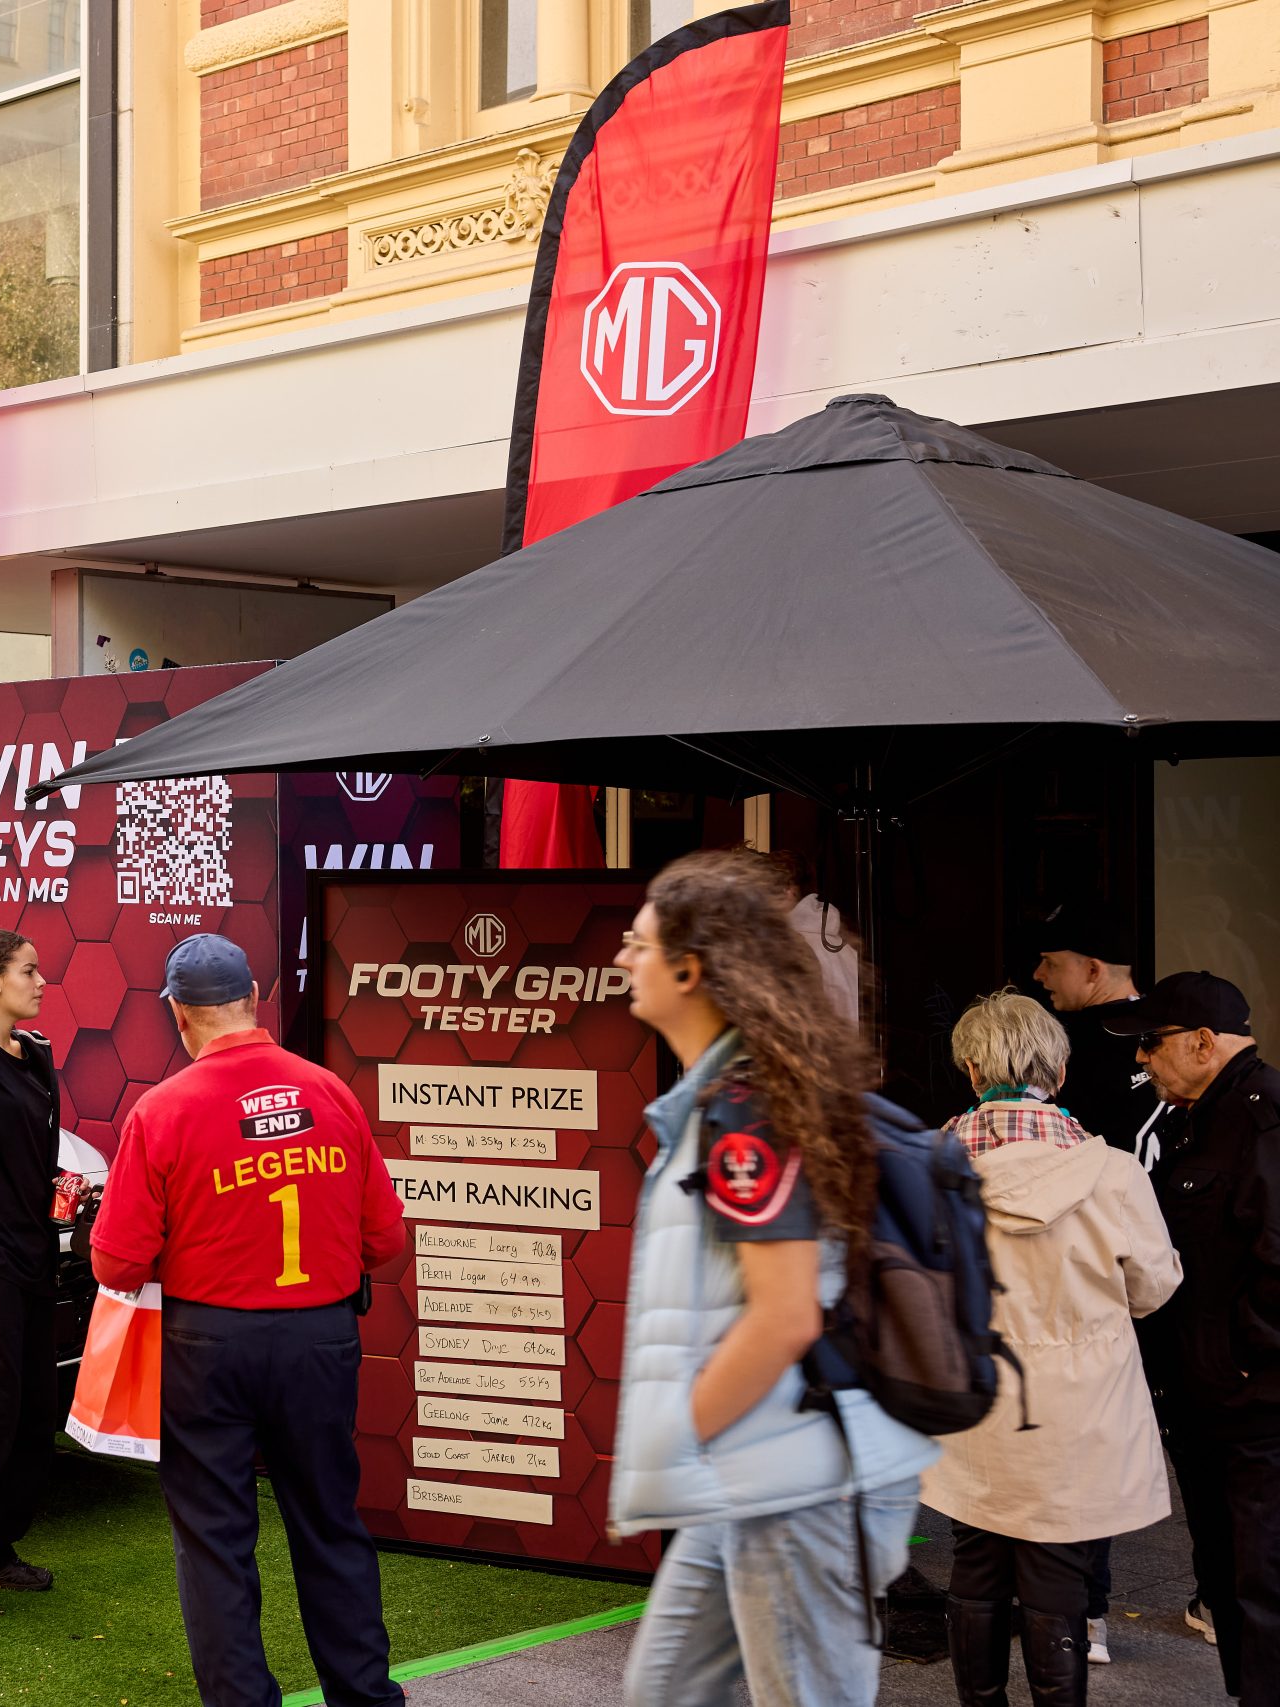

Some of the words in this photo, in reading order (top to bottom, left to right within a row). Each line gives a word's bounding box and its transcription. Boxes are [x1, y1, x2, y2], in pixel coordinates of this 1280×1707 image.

[593, 276, 708, 401] MG
[28, 878, 69, 903] MG
[149, 912, 181, 925] SCAN
[183, 913, 202, 926] ME
[468, 919, 503, 953] MG
[348, 963, 509, 1001] FOOTY
[514, 966, 631, 1002] GRIP
[420, 1006, 556, 1034] TESTER
[240, 1090, 300, 1115] WEST
[391, 1082, 503, 1108] INSTANT
[512, 1087, 584, 1111] PRIZE
[254, 1113, 301, 1136] END
[431, 1134, 458, 1150] 55kg
[480, 1136, 503, 1150] 35kg
[522, 1138, 547, 1154] 25kg
[213, 1145, 347, 1195] LEGEND
[390, 1177, 456, 1203] TEAM
[466, 1182, 592, 1211] RANKING
[268, 1183, 310, 1287] 1
[419, 1231, 477, 1249] MELBOURNE
[488, 1236, 518, 1258] Larry
[421, 1262, 452, 1280] PERTH
[460, 1266, 486, 1285] Logan
[423, 1295, 473, 1313] ADELAIDE
[425, 1332, 470, 1349] SYDNEY
[437, 1370, 471, 1385] ADELAIDE
[475, 1374, 506, 1390] Jules
[423, 1402, 470, 1421] GEELONG
[411, 1485, 463, 1504] BRISBANE
